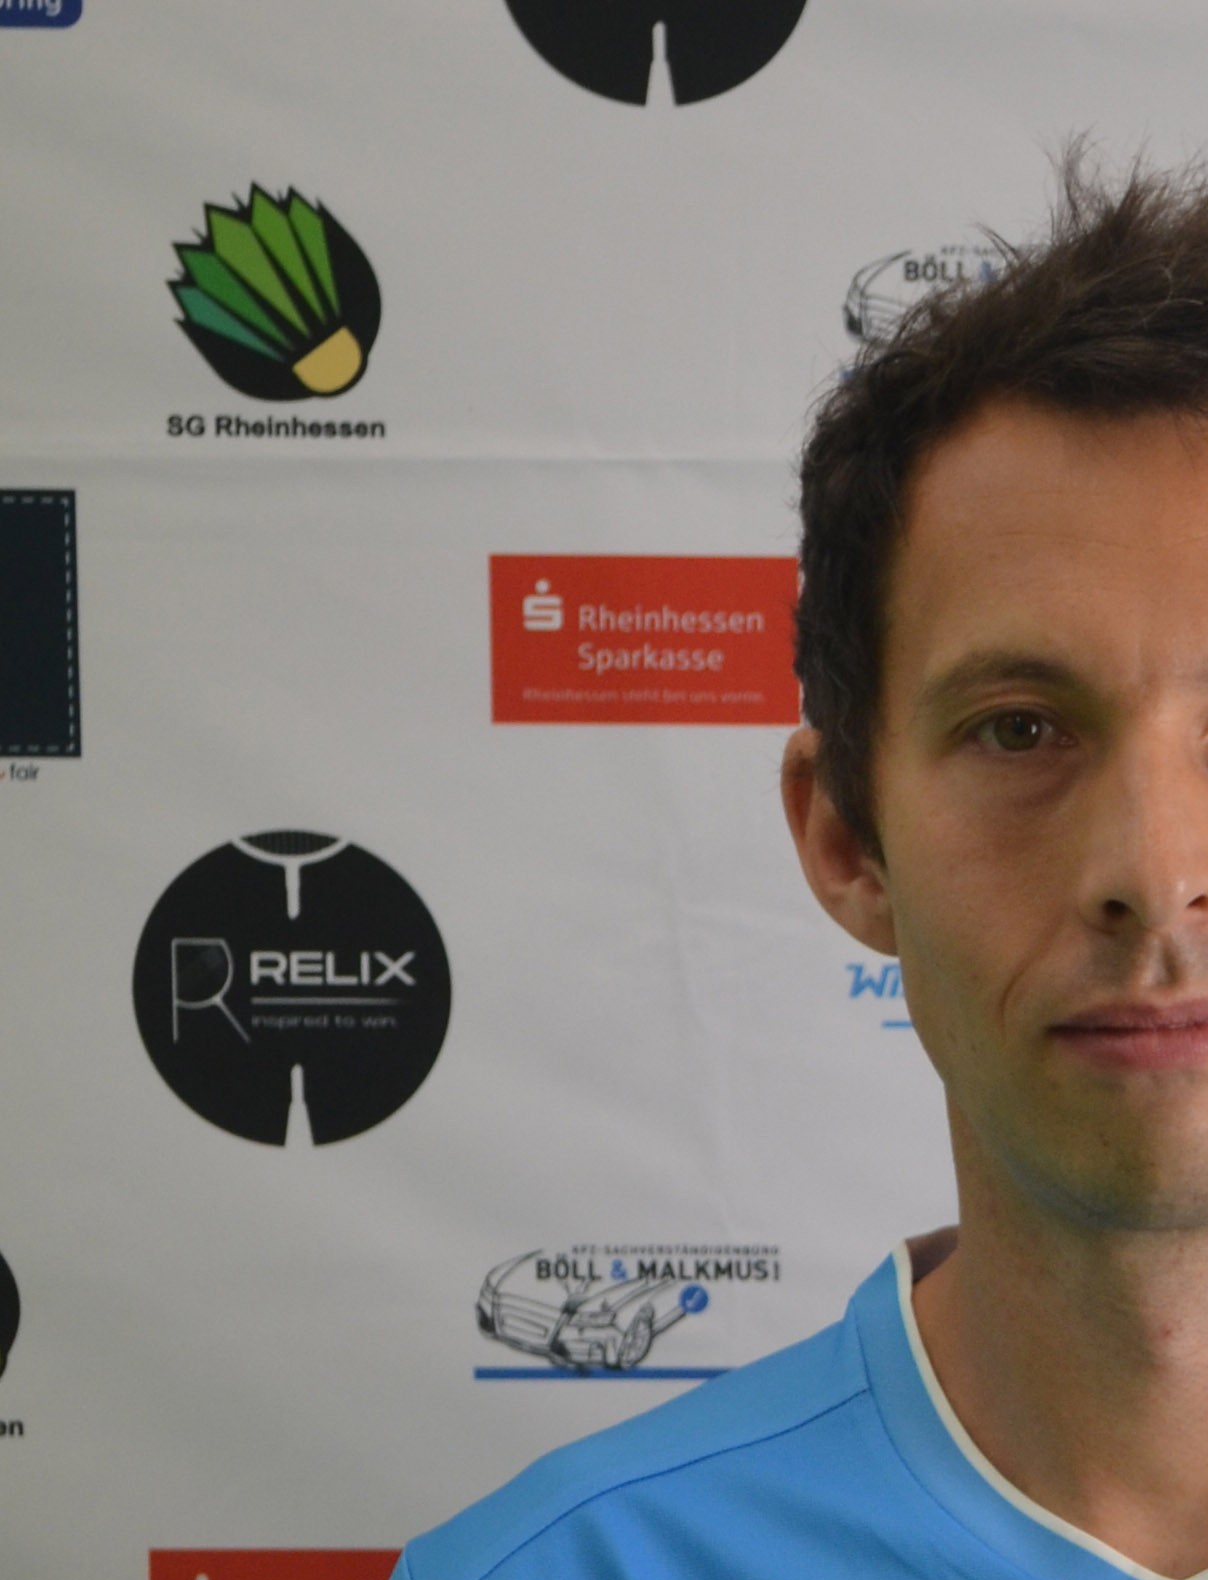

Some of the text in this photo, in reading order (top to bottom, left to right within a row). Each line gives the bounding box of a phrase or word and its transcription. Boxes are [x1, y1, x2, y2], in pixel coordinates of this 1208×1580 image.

[166, 413, 387, 438] SG Rheinhessen
[576, 603, 766, 633] Rheinhessen
[576, 642, 726, 676] Sparkasse
[250, 951, 417, 986] RELIX
[535, 1253, 602, 1281] BÖLL
[610, 1259, 628, 1282] &
[637, 1260, 769, 1281] MALKMUS
